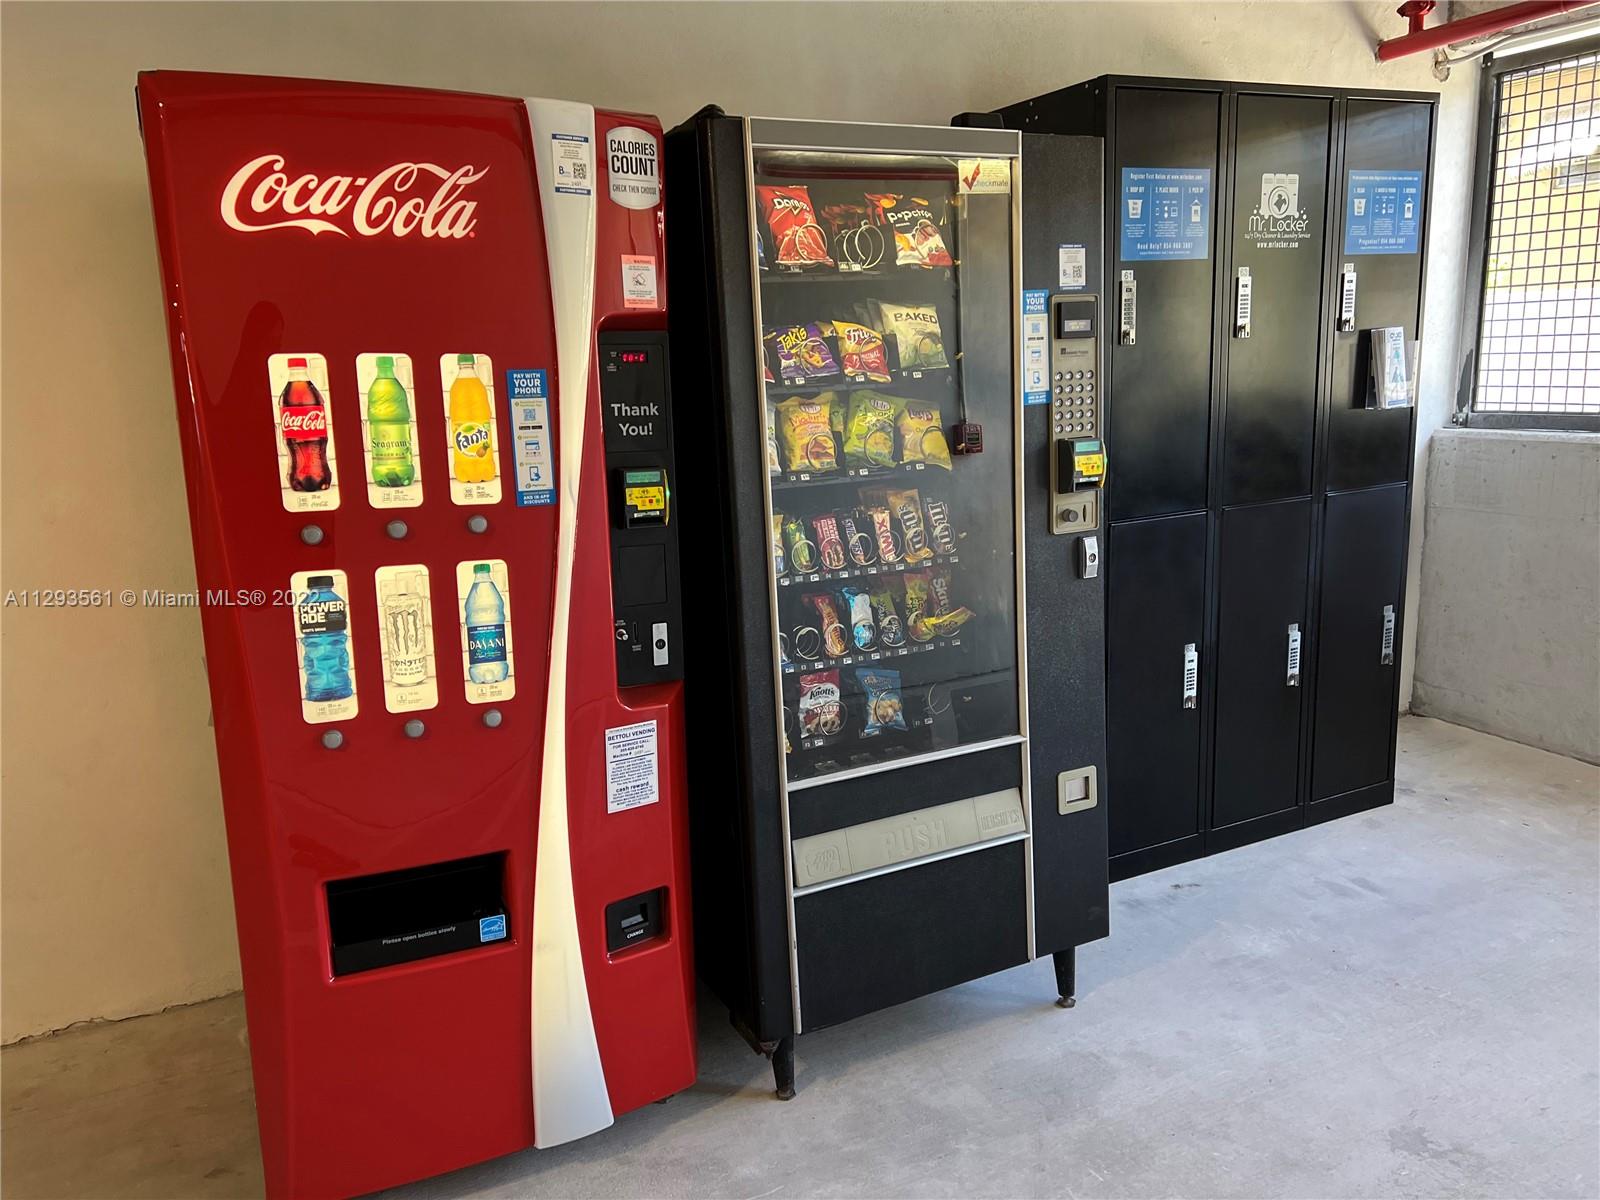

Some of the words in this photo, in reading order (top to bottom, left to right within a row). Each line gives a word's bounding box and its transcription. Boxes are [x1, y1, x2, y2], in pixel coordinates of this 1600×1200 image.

[610, 139, 655, 156] CALORIES
[611, 155, 656, 176] COUNT
[220, 154, 490, 239] Coca-Cola
[612, 184, 628, 193] CHECK
[628, 185, 641, 194] THEN
[640, 186, 657, 195] CHOOSE
[1248, 215, 1266, 231] Mr.
[1270, 215, 1309, 232] Locker
[1026, 297, 1045, 305] YOUR
[894, 312, 938, 324] BAKED
[778, 327, 808, 353] Takis
[514, 379, 541, 387] YOUR
[611, 403, 659, 416] Thank
[282, 411, 325, 431] Coca-Cola
[619, 422, 653, 436] You!
[456, 428, 488, 451] Fanta
[300, 601, 344, 614] POWER
[301, 612, 326, 625] ADE
[470, 638, 505, 650] DASANI
[809, 686, 835, 700] Knott's
[607, 732, 631, 742] BETTOLI
[632, 727, 655, 737] VENDING
[622, 740, 639, 748] SERVICE
[616, 784, 629, 793] cash
[630, 781, 650, 790] reward
[885, 818, 948, 860] PUSH
[382, 937, 401, 945] Please
[402, 934, 417, 942] open
[417, 930, 438, 938] bottles
[438, 926, 456, 934] slowly
